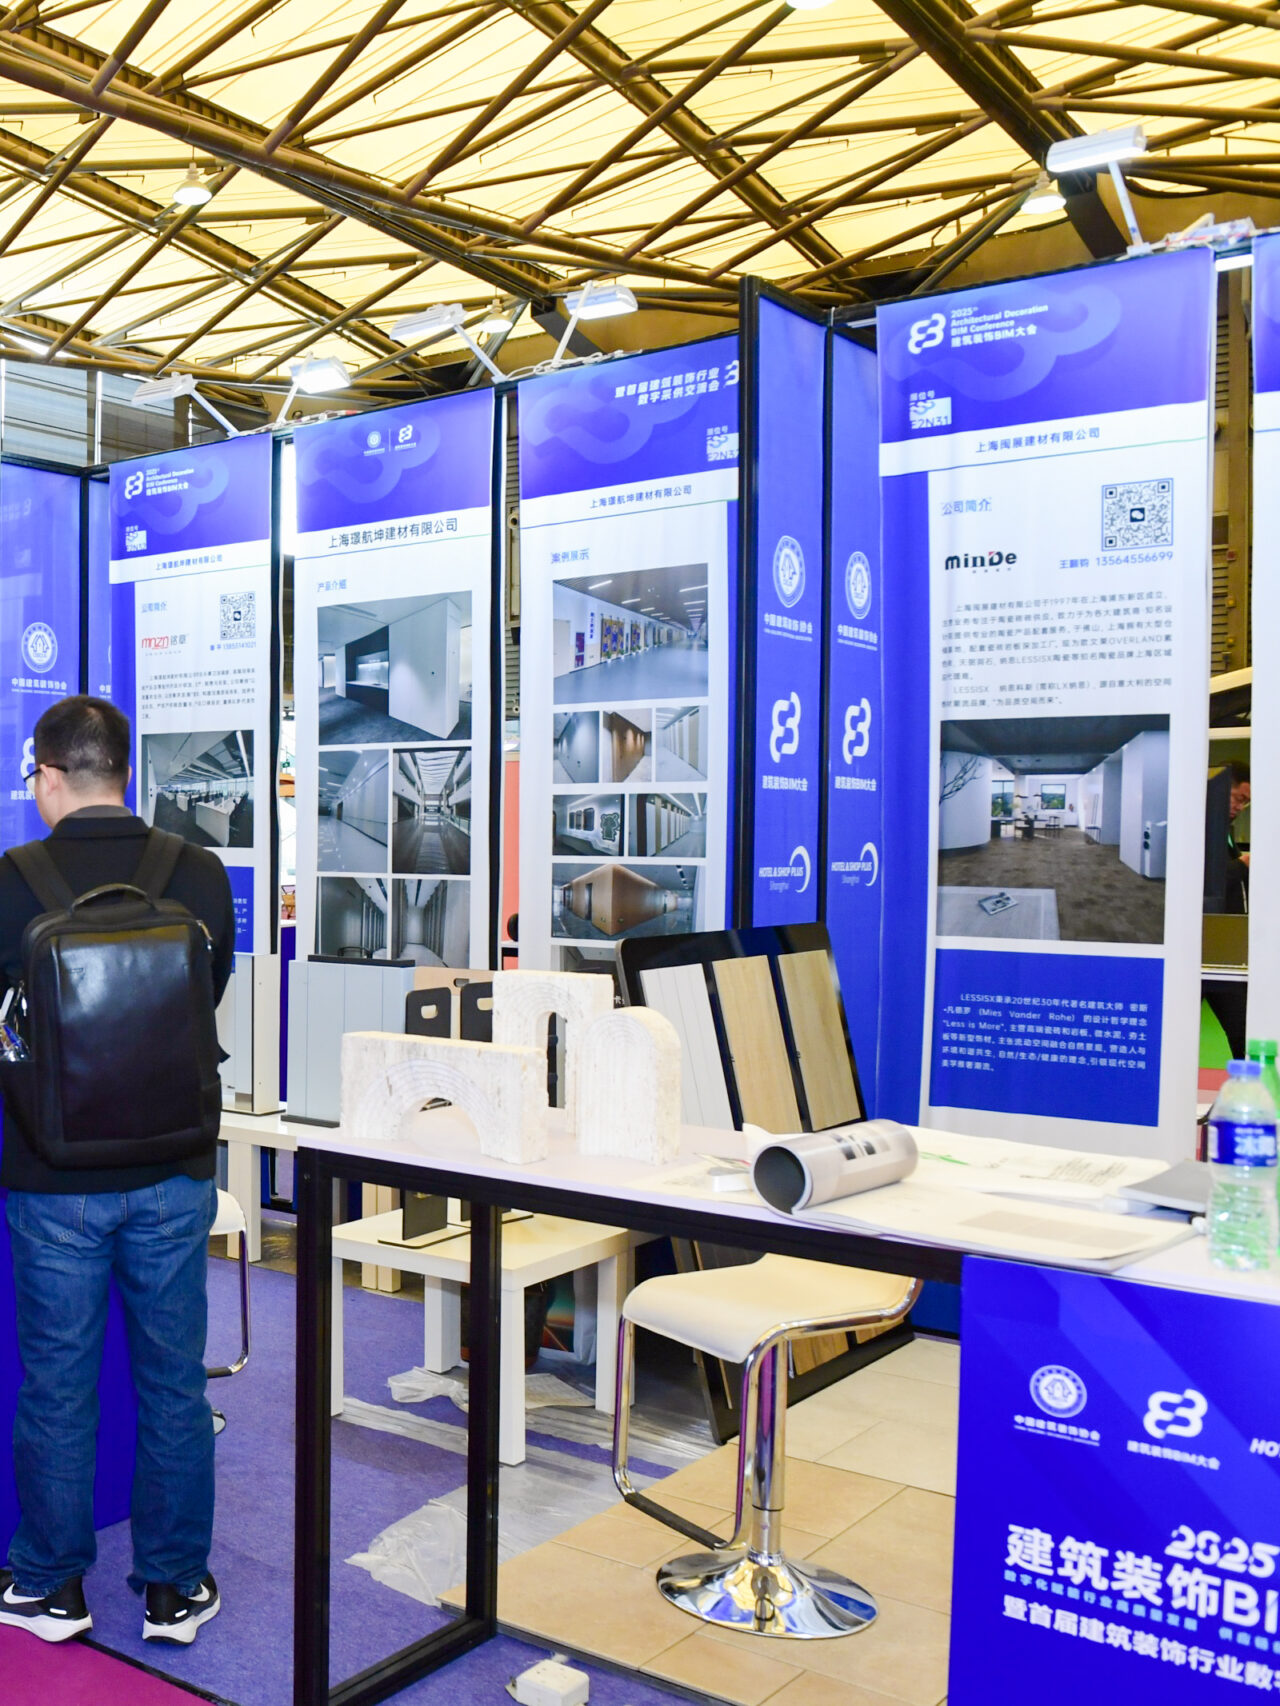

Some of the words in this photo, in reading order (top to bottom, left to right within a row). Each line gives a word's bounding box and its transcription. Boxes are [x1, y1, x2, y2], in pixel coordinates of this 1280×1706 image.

[951, 312, 1002, 327] Architectural
[1004, 305, 1048, 318] Decoration
[951, 327, 968, 336] BIM
[970, 320, 1015, 333] Conference
[951, 324, 1037, 347] 建筑装饰BIM大会
[942, 498, 992, 515] 公司简介
[551, 548, 590, 562] 案例展示
[1096, 551, 1173, 566] 13564556699
[1250, 1438, 1280, 1457] HO
[1164, 1525, 1280, 1578] 2025
